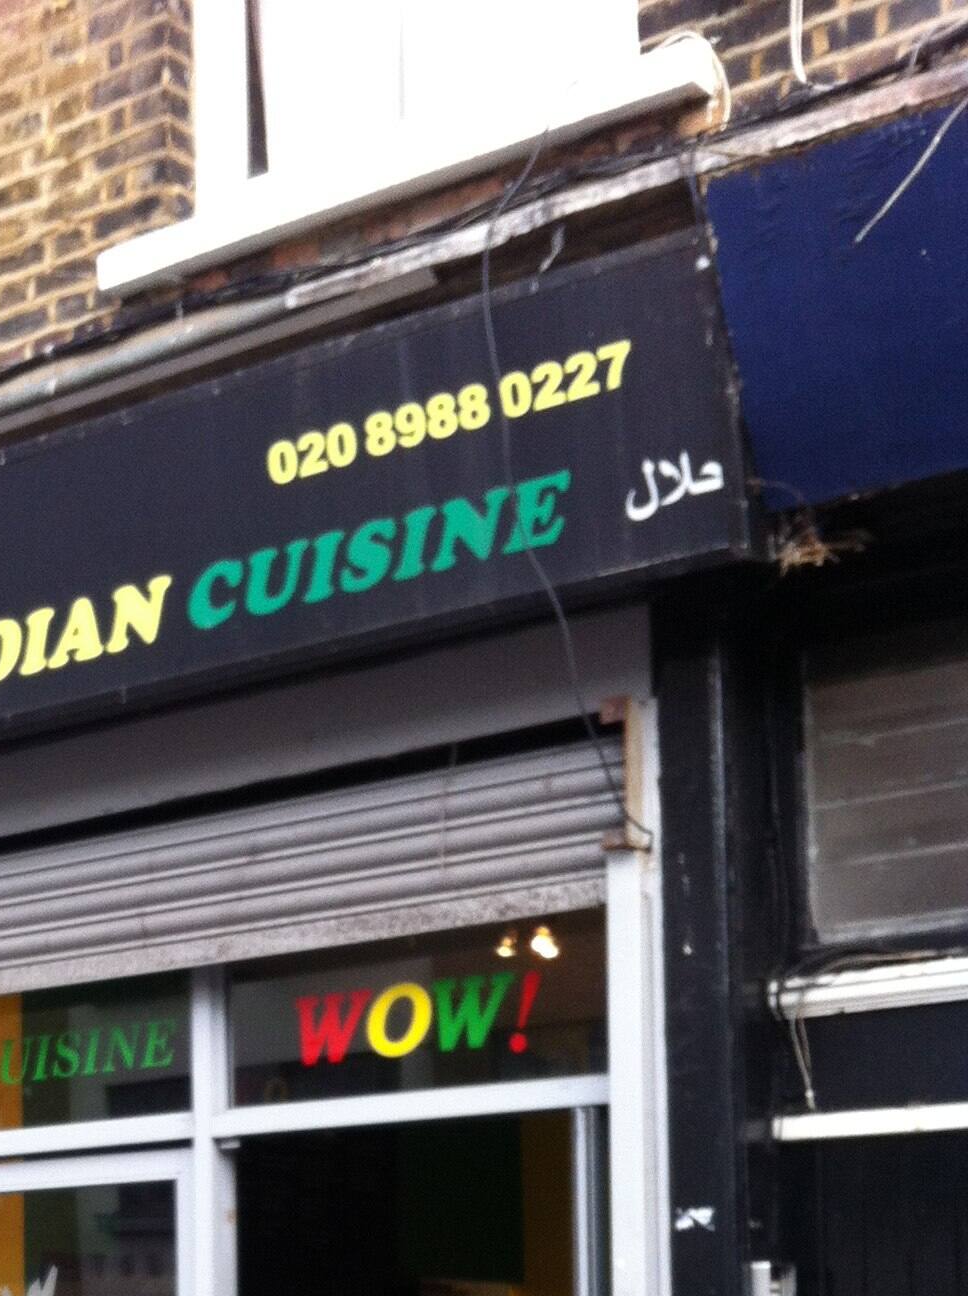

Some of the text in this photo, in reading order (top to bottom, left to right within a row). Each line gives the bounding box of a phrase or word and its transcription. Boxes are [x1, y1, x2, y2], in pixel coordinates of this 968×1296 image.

[267, 340, 632, 485] 020 8988 0227
[625, 450, 725, 521] حلال
[186, 470, 571, 630] CUISINE
[295, 971, 540, 1067] WOW!
